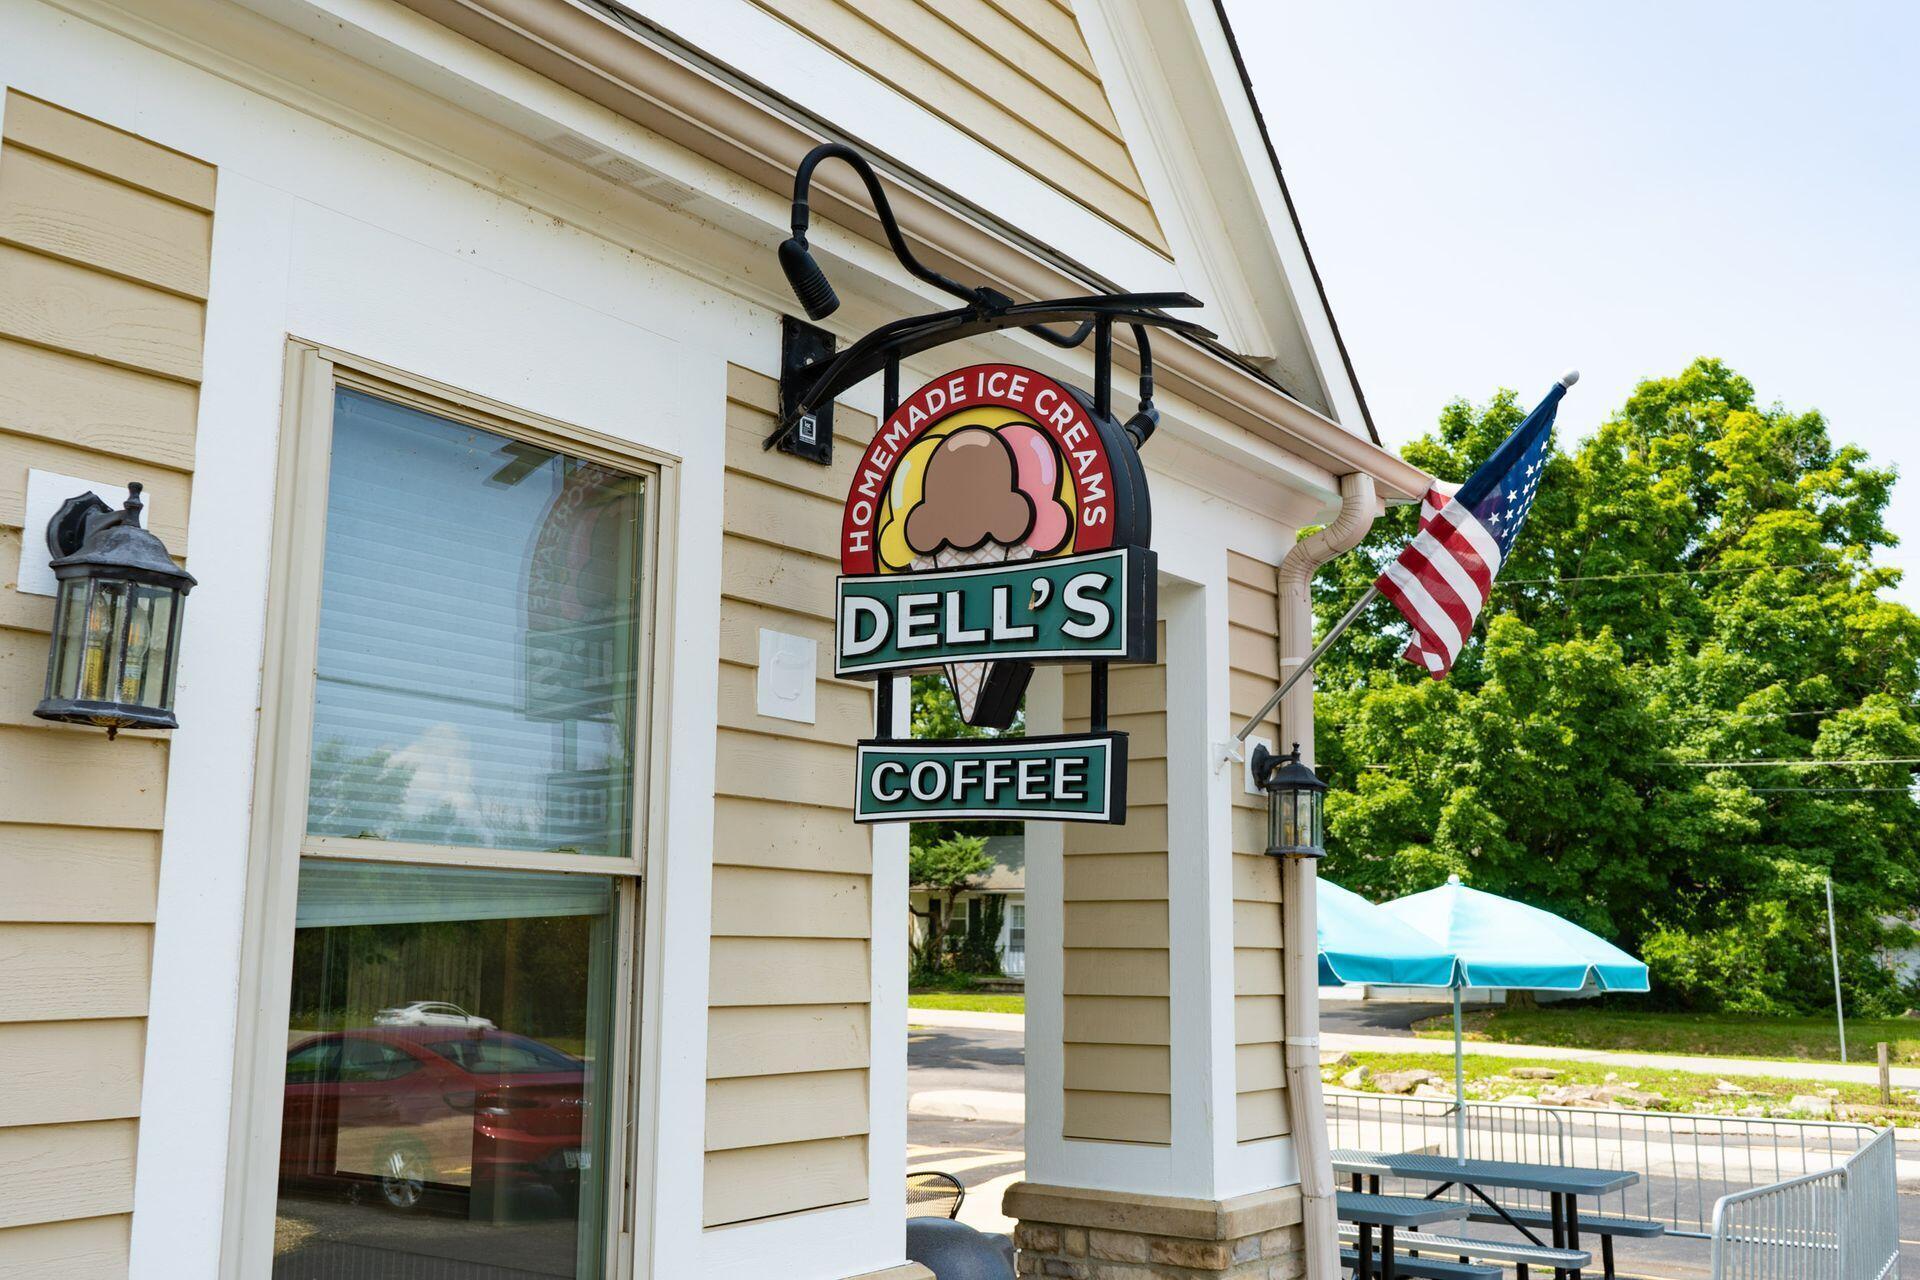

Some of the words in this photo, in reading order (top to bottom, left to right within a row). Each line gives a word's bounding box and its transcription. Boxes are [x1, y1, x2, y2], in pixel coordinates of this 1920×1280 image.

[849, 376, 967, 553] HOMEMADE
[977, 372, 1030, 403] ICE
[1034, 389, 1107, 527] CREAMS
[842, 572, 1114, 657] DELL'S
[870, 757, 1089, 803] COFFEE
